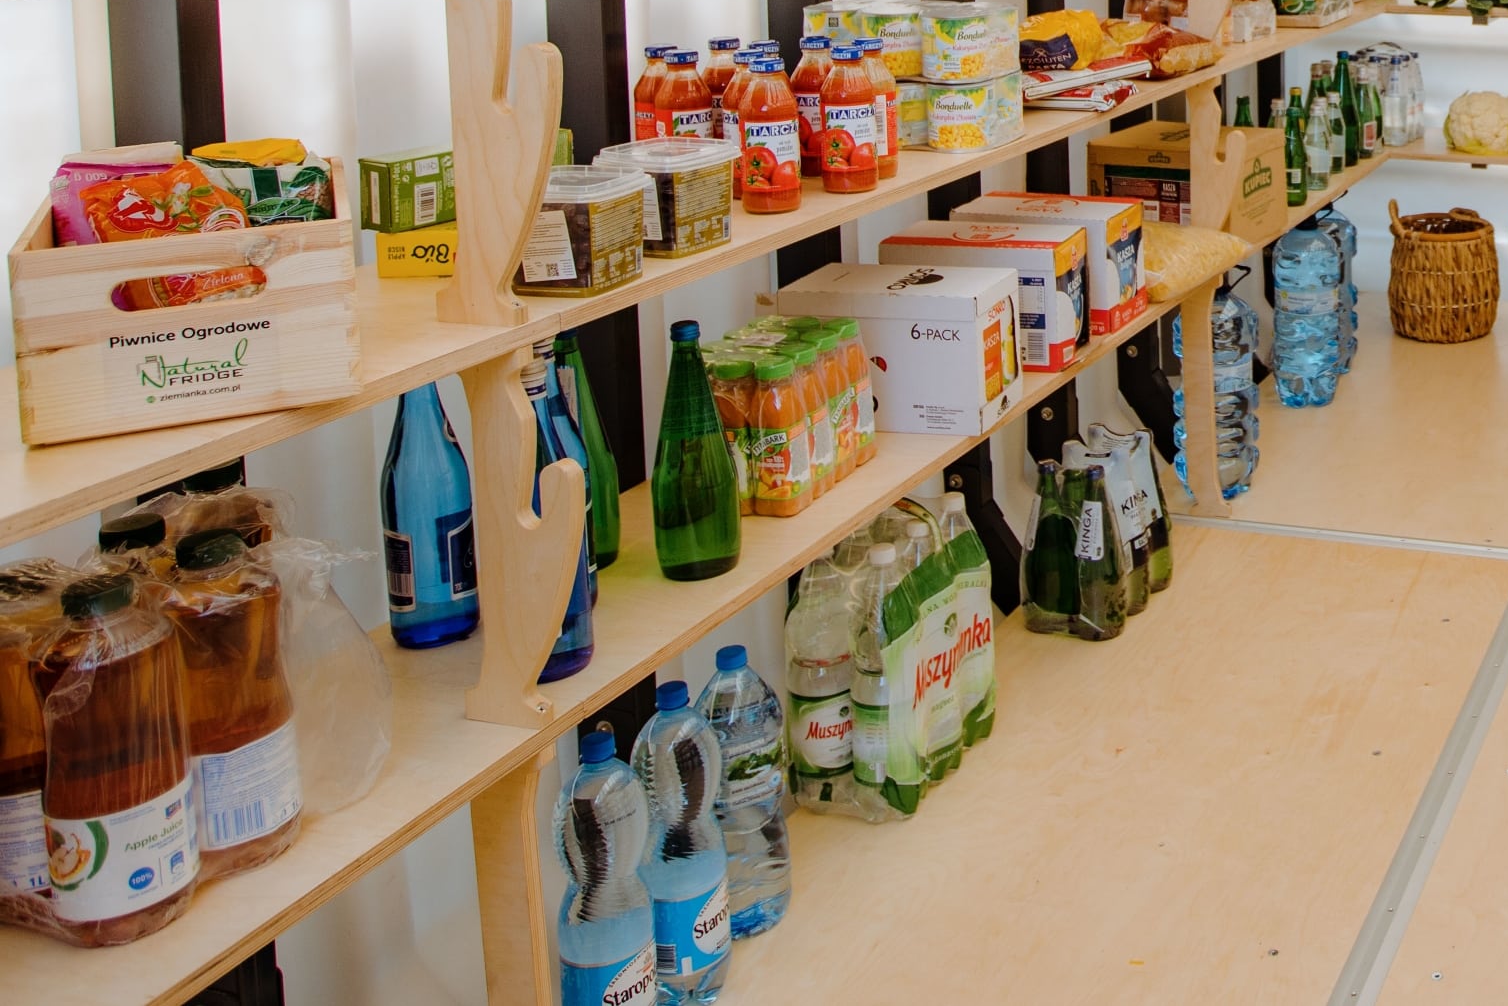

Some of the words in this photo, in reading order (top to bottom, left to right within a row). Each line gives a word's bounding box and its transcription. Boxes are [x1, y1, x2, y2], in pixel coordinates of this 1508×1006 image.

[935, 98, 973, 113] Bonduelle
[1244, 170, 1271, 195] KUPIEC
[1117, 243, 1135, 262] KASZA
[109, 331, 176, 348] Piwnice
[181, 320, 271, 340] Ogrodowe
[911, 323, 961, 342] 6-PACK
[141, 337, 249, 389] Natural
[169, 368, 244, 387] FRIDGE
[159, 383, 241, 403] ziemianka.com.pl
[1081, 507, 1093, 553] KINGA
[125, 832, 159, 853] Apple
[131, 872, 154, 886] 100%
